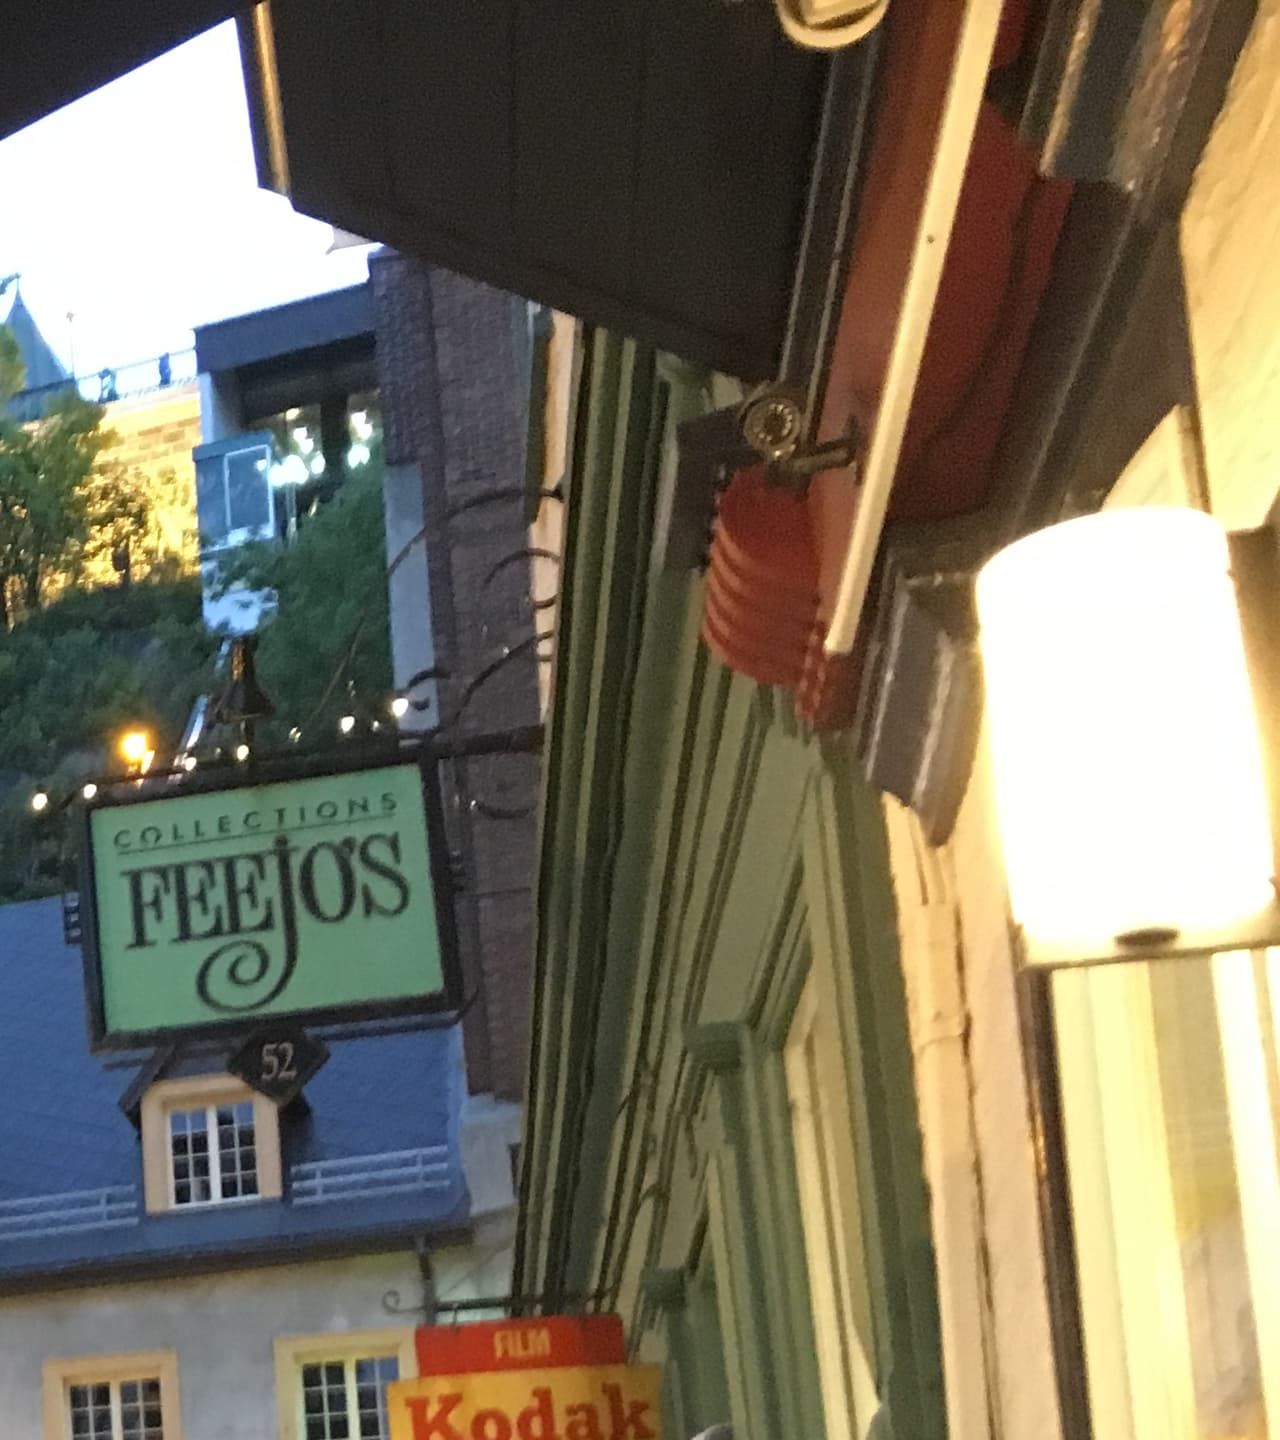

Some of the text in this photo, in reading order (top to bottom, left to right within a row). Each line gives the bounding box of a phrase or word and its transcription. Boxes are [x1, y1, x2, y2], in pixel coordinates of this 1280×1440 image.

[113, 792, 397, 850] COLLECTIONS
[260, 1042, 297, 1082] 52
[493, 1327, 551, 1361] FILM
